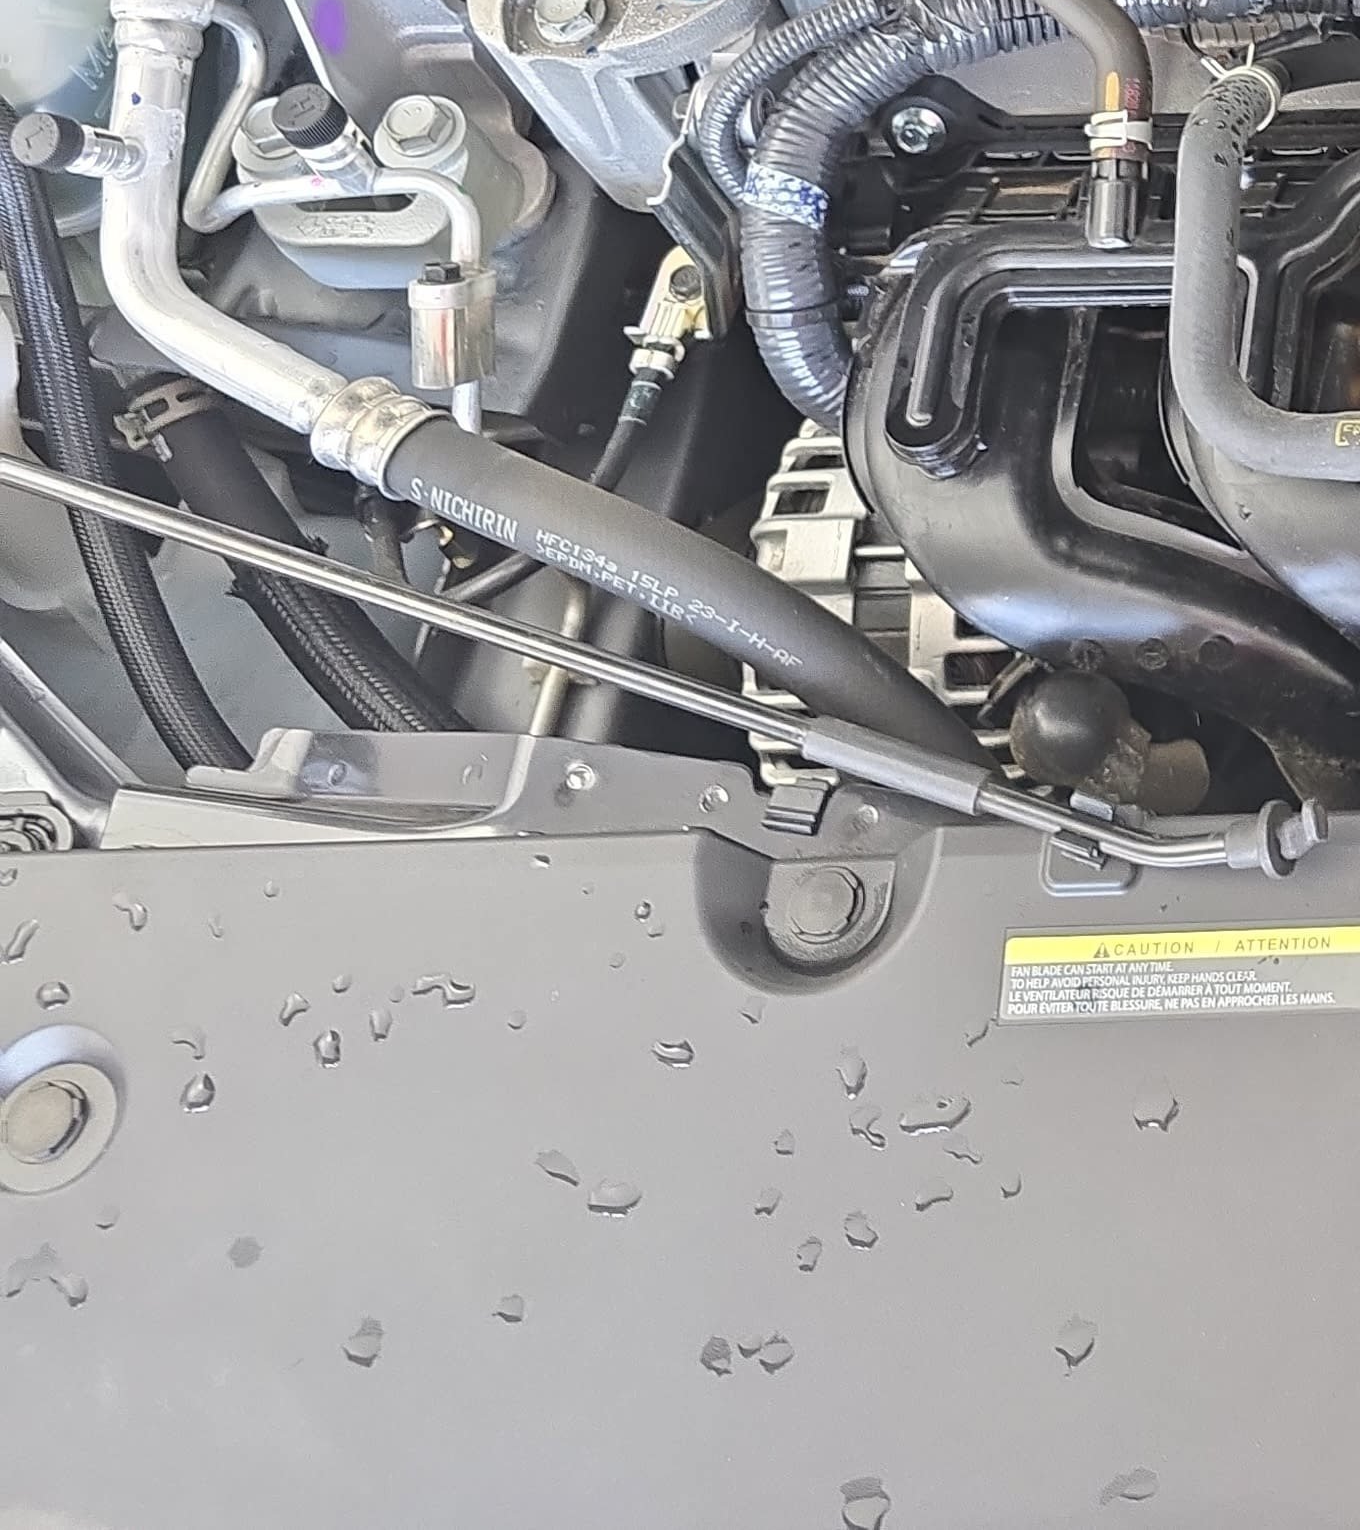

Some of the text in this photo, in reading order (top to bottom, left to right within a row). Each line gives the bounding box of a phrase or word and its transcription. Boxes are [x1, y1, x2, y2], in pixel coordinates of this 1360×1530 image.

[627, 568, 680, 604] 15LP
[1114, 942, 1194, 956] CAUTION
[1235, 936, 1331, 952] ATTENTION
[1012, 966, 1031, 977] FAN
[1032, 966, 1062, 976] BLADE
[1064, 965, 1084, 975] CAN
[1086, 964, 1114, 975] START
[1115, 963, 1127, 974] AT
[1128, 963, 1149, 973] ANY
[1011, 978, 1024, 989] TO
[1026, 977, 1050, 988] HELP
[1051, 976, 1081, 988] AVOID
[1082, 975, 1130, 987] PERSONAL
[1167, 973, 1189, 983] KEEP
[1191, 972, 1224, 983] HANDS
[1009, 991, 1020, 1002] LE
[1021, 989, 1090, 1001] VENTILATEUR
[1092, 987, 1129, 1000] RISQUE
[1131, 986, 1145, 998] DE
[1147, 984, 1202, 997] DÉMARRER
[1203, 983, 1212, 995] À
[1213, 984, 1241, 994] TOUT
[1008, 1004, 1038, 1014] POUR
[1039, 1001, 1074, 1014] ÉVITER
[1075, 1001, 1110, 1013] TOUTE
[1164, 998, 1180, 1009] NE
[1181, 997, 1200, 1009] PAS
[1201, 996, 1216, 1008] EN
[1217, 995, 1280, 1007] APPROCHER
[1281, 994, 1299, 1005] LES
